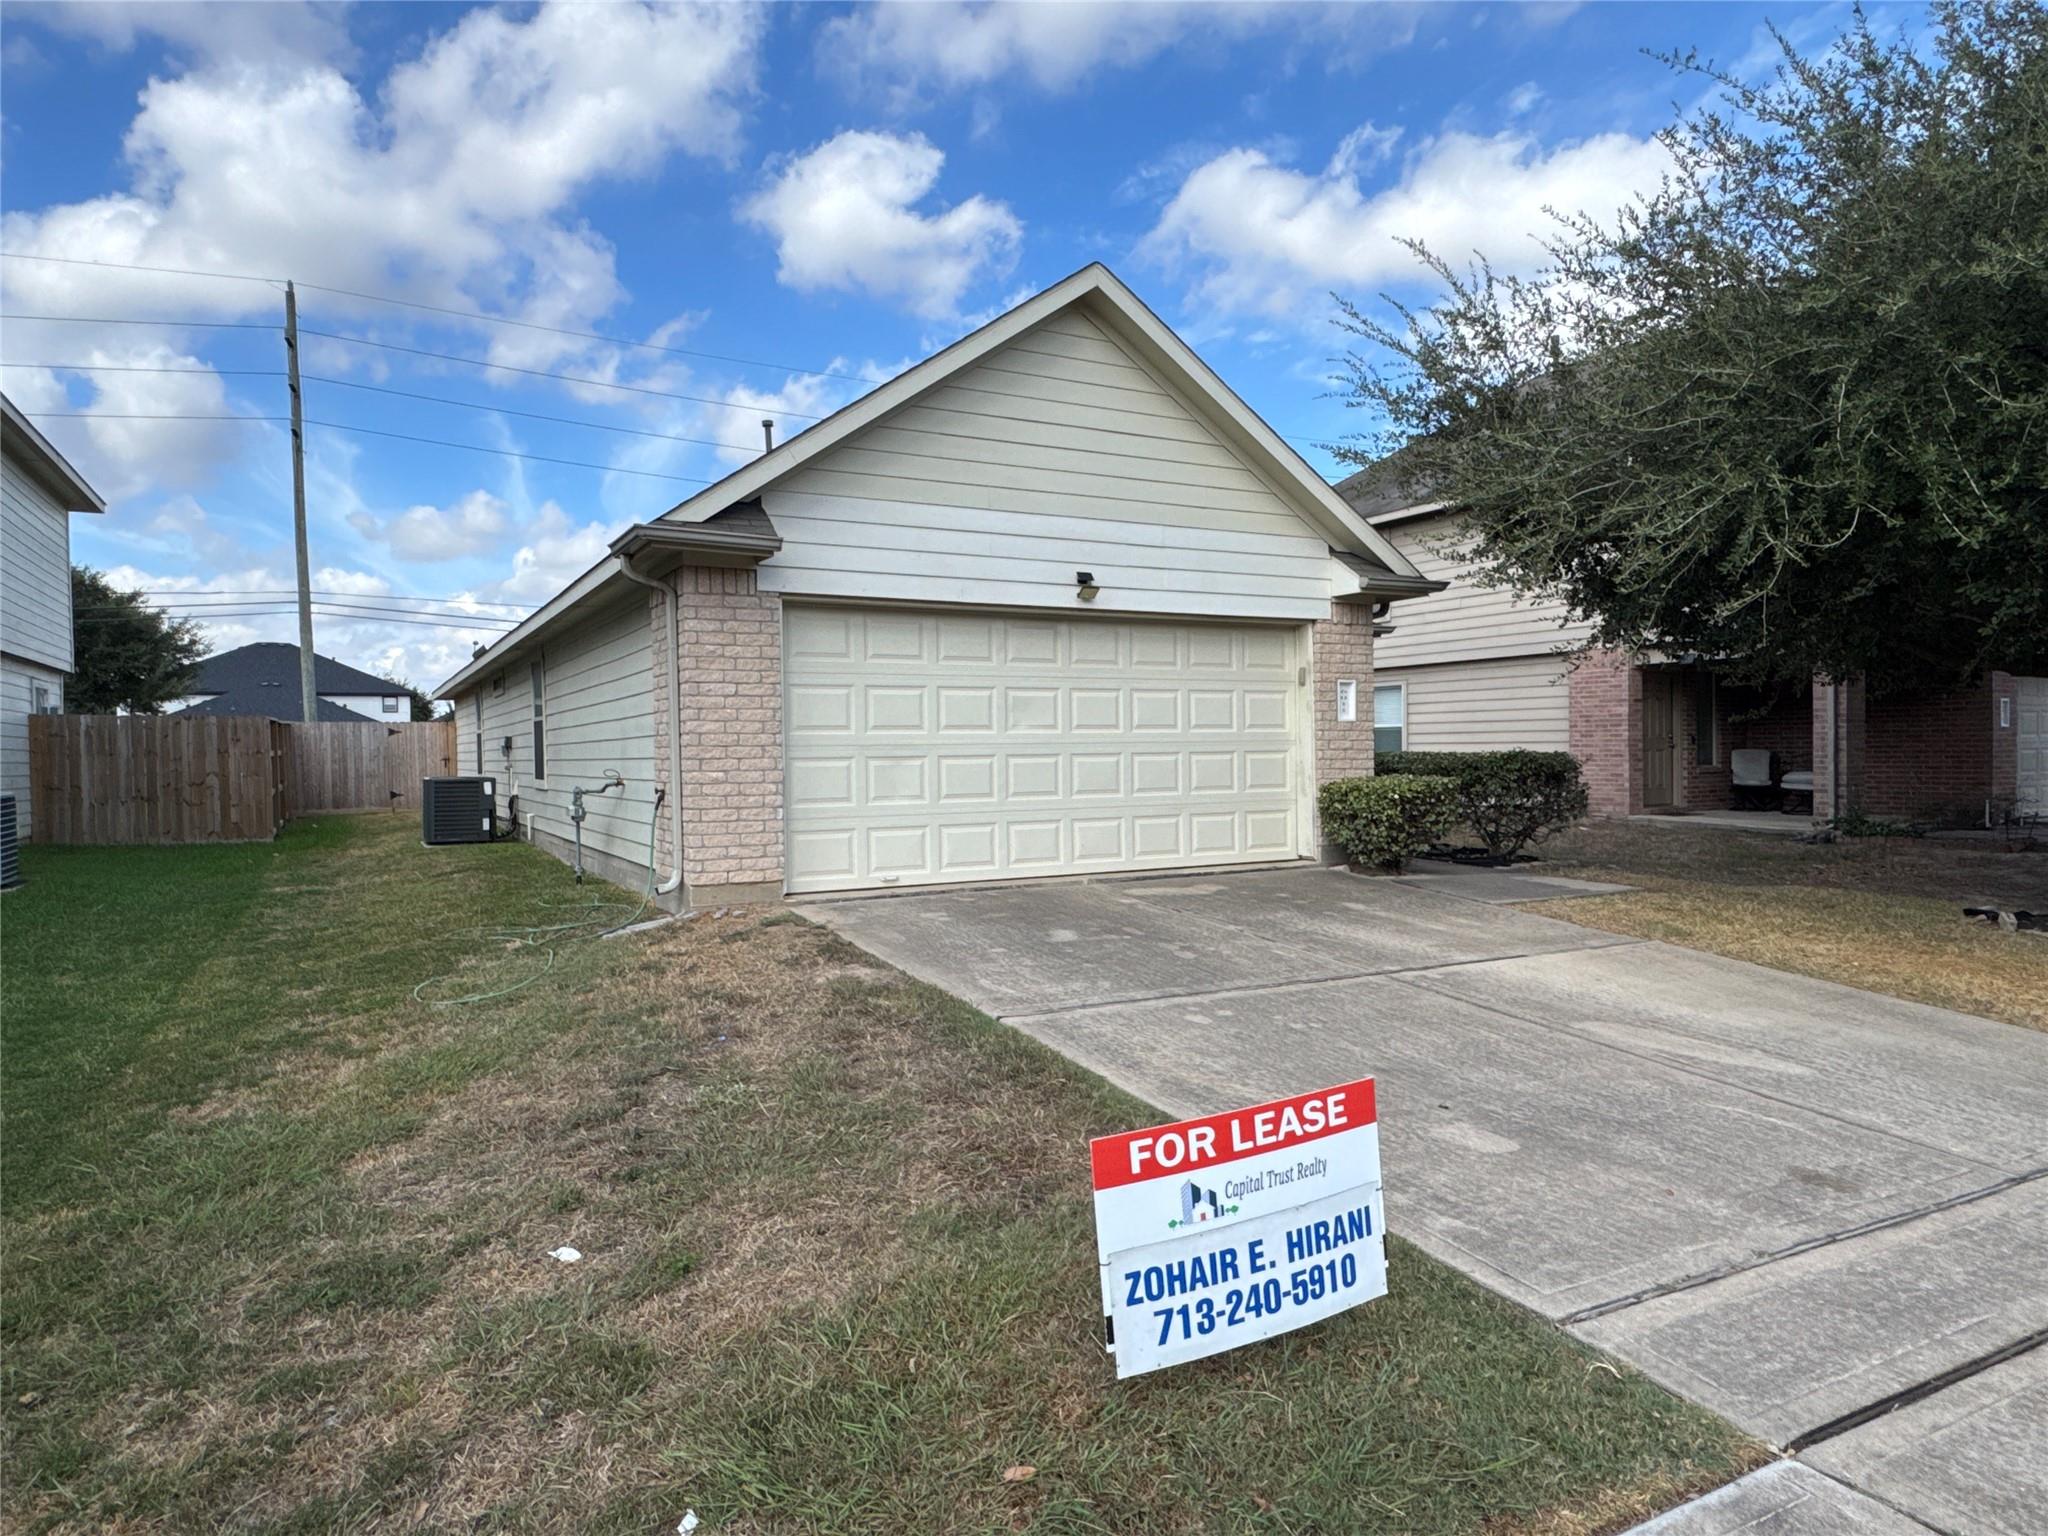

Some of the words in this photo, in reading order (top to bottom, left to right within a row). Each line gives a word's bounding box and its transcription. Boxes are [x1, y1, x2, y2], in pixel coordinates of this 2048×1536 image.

[1129, 1125, 1217, 1175] FOR
[1230, 1092, 1348, 1152] LEASE
[1225, 1171, 1264, 1200] Capital
[1266, 1166, 1295, 1188] Trust
[1296, 1157, 1328, 1180] Realty
[1125, 1248, 1239, 1307] ZOHAIR
[1248, 1239, 1276, 1274] E.
[1286, 1205, 1372, 1262] HIRANI
[1153, 1253, 1357, 1346] 713-240-5910
